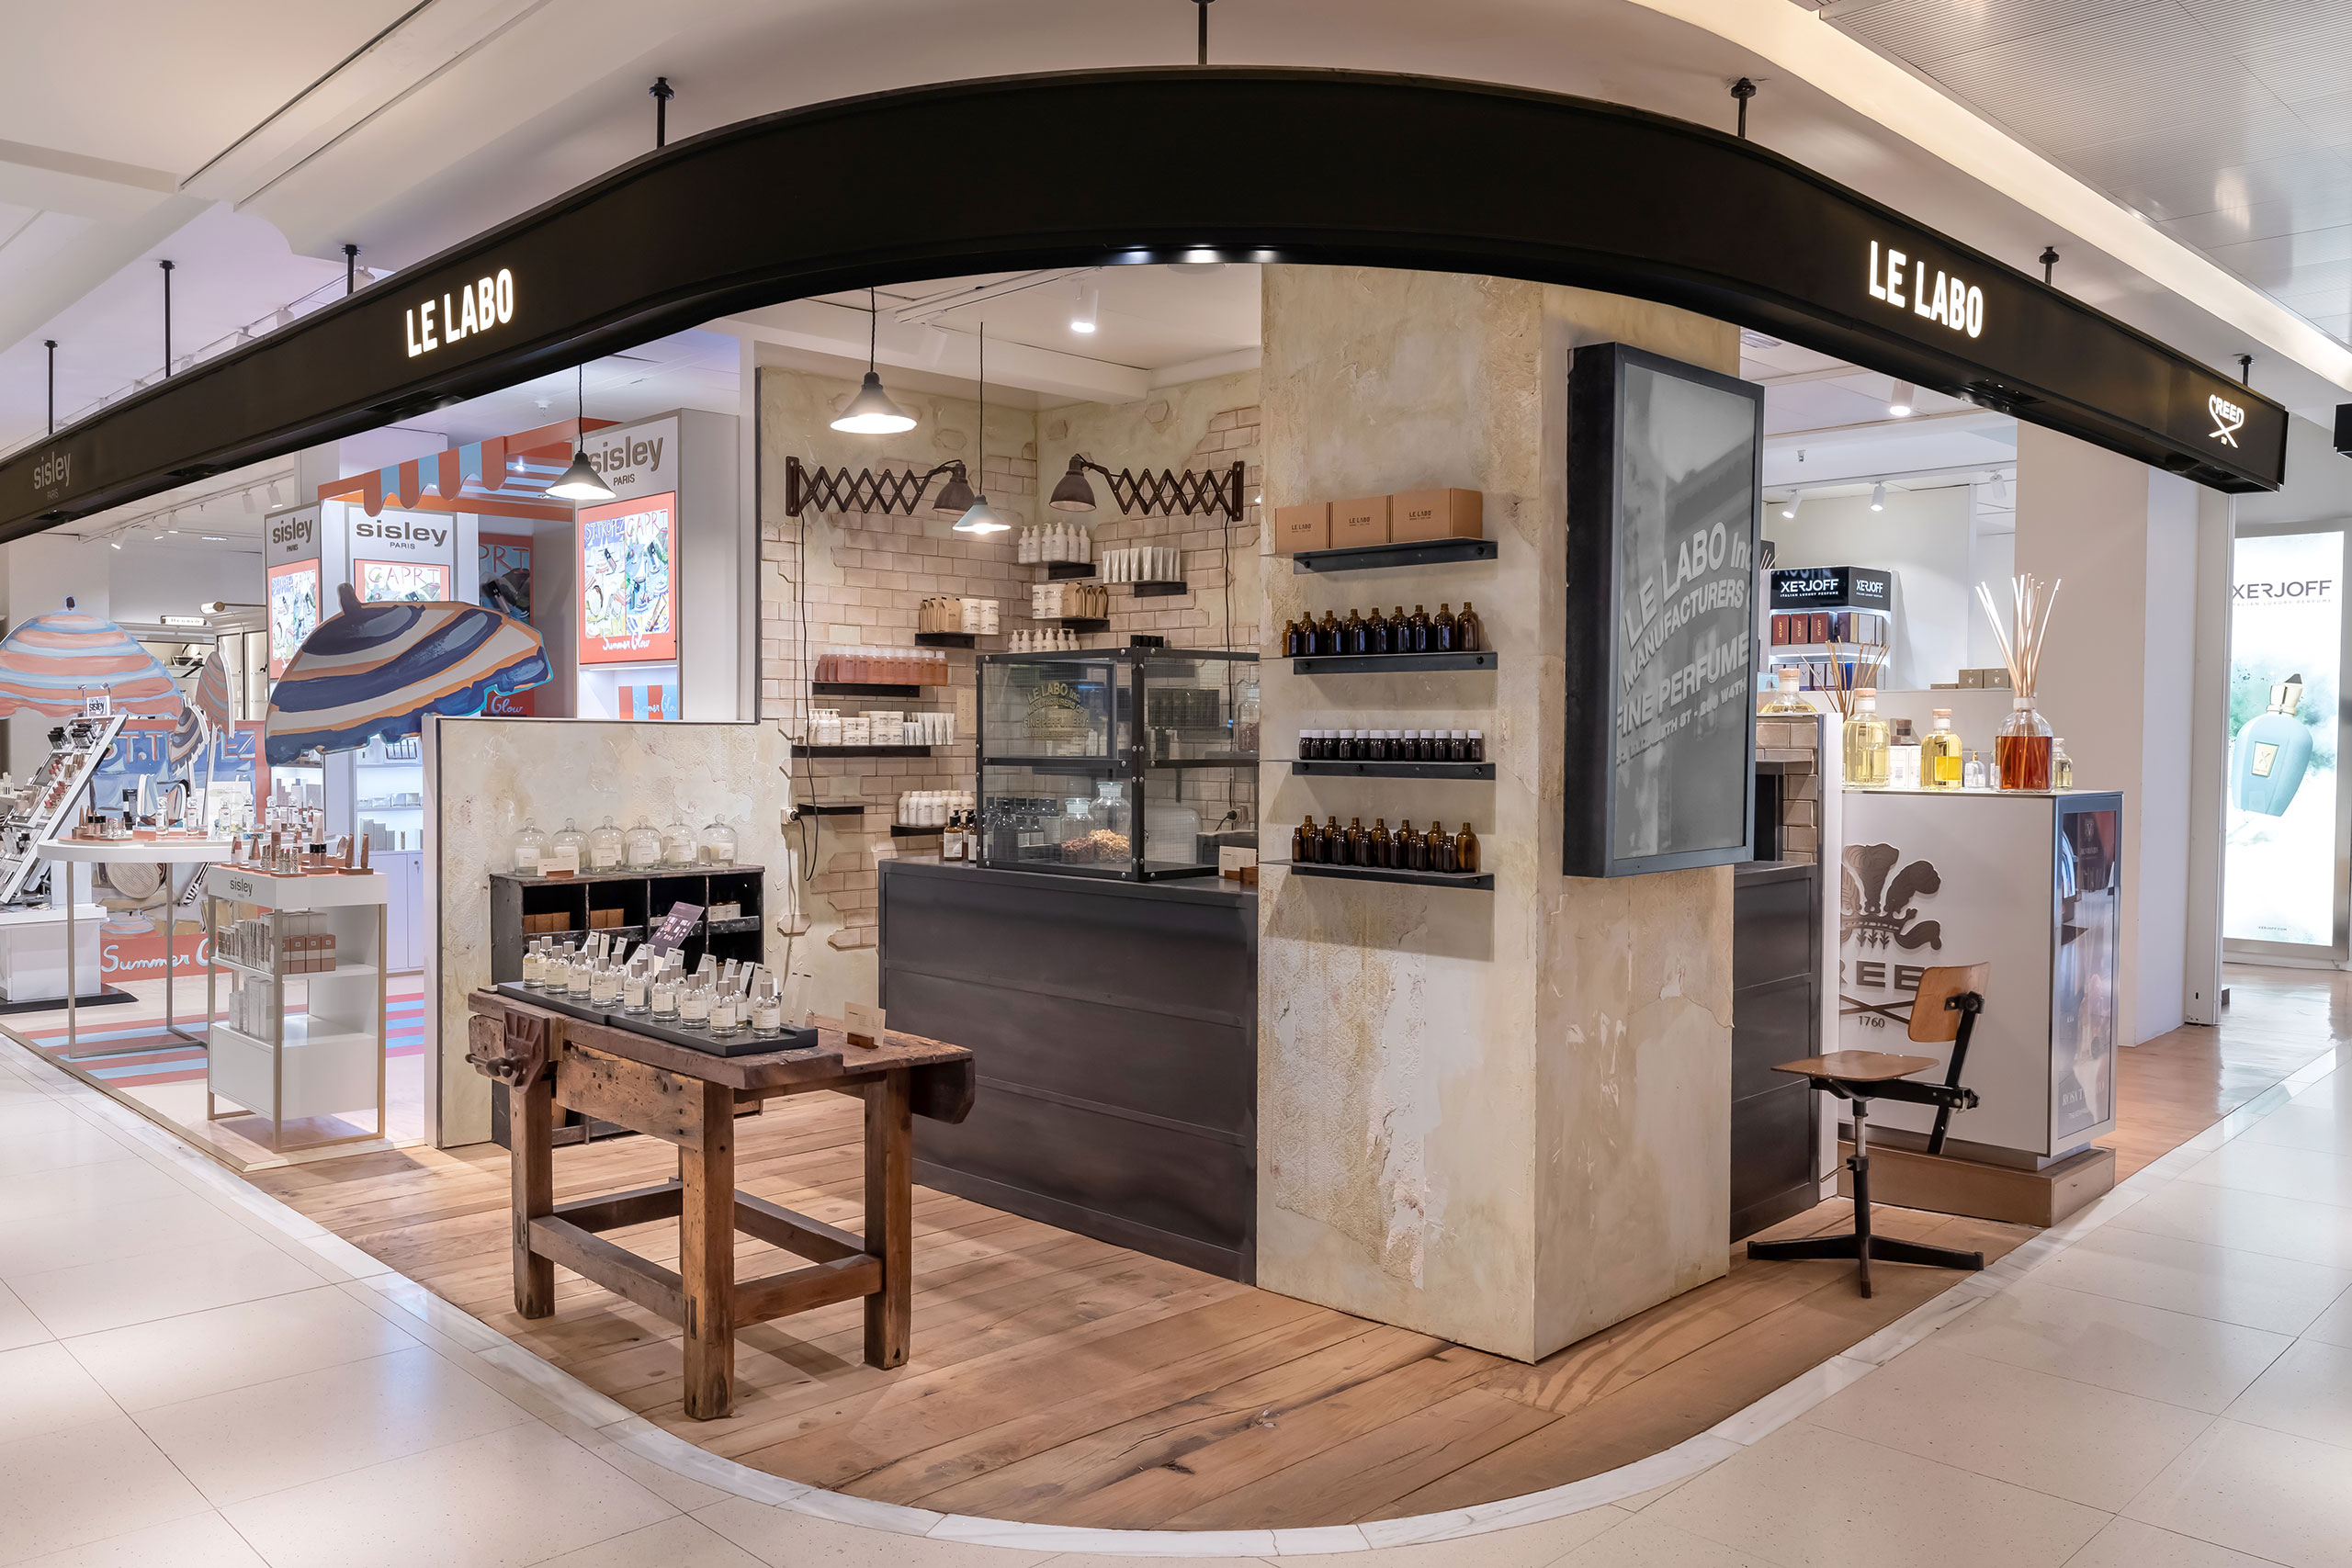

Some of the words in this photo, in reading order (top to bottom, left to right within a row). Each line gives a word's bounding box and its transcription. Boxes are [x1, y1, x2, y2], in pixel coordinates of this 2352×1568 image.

[1869, 240, 1907, 309] LE
[1914, 260, 1984, 338] LABO
[406, 299, 438, 358] LE
[444, 268, 514, 344] LABO
[2208, 394, 2245, 429] CREED
[588, 435, 664, 472] sisley
[33, 451, 71, 490] sisley
[613, 473, 636, 486] PARIS
[272, 516, 313, 544] sisley
[356, 519, 448, 547] sisley
[626, 510, 669, 537] CAPRI
[390, 542, 416, 550] PARIS
[480, 543, 530, 574] PRI
[368, 566, 441, 588] CAPRI
[1624, 575, 1657, 652] LE
[1661, 522, 1727, 605] LABO
[1780, 578, 1839, 593] XERJOFF
[1856, 579, 1883, 593] XERJOFF
[2233, 580, 2333, 601] XERJOFF
[1623, 579, 1746, 696] MANUFACTURERS
[1041, 682, 1069, 697] LABO
[491, 695, 523, 715] Glow
[230, 876, 253, 897] sisley
[1859, 1015, 1885, 1028] 1760
